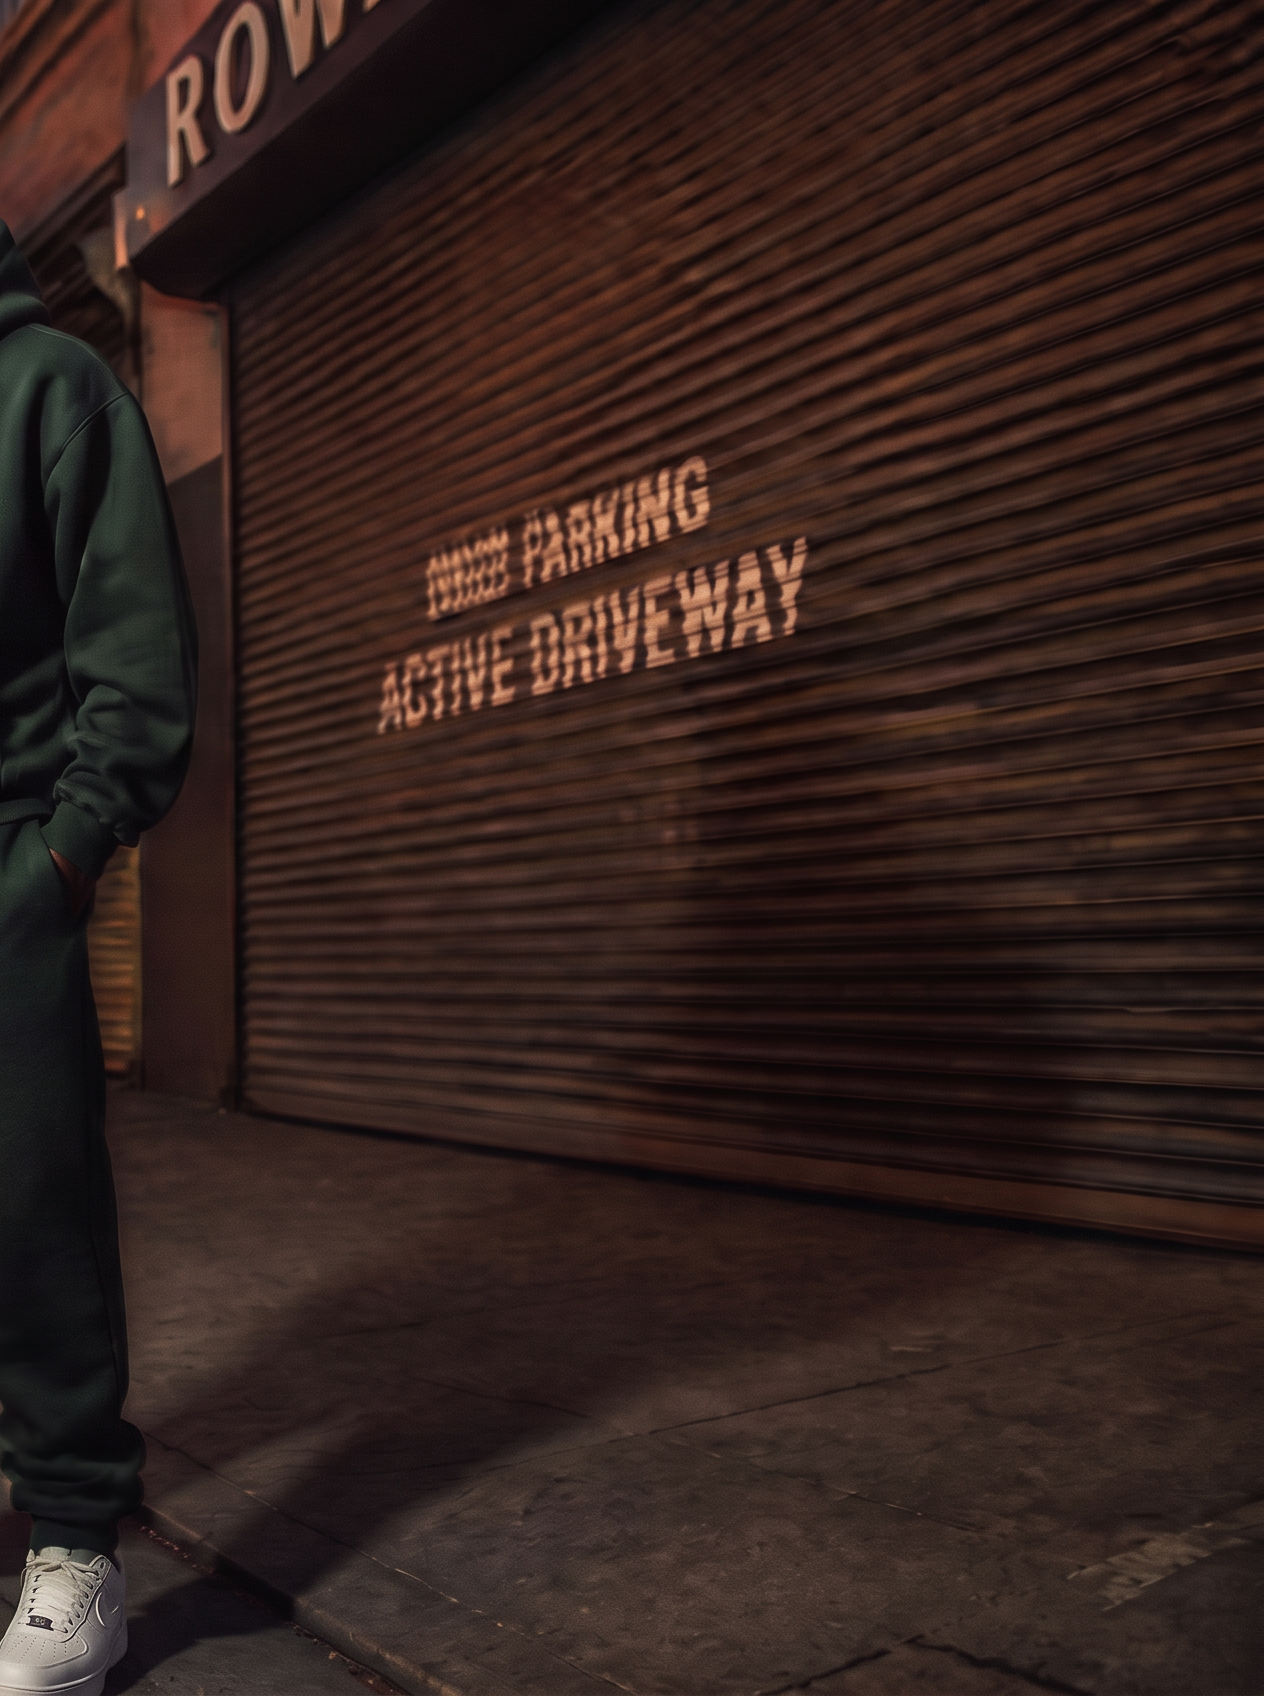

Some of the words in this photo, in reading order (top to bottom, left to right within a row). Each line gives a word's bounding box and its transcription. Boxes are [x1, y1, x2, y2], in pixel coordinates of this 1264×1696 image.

[522, 456, 711, 588] PARKING
[377, 622, 515, 733] ACTIVE
[529, 536, 809, 695] DRIVEWAY
